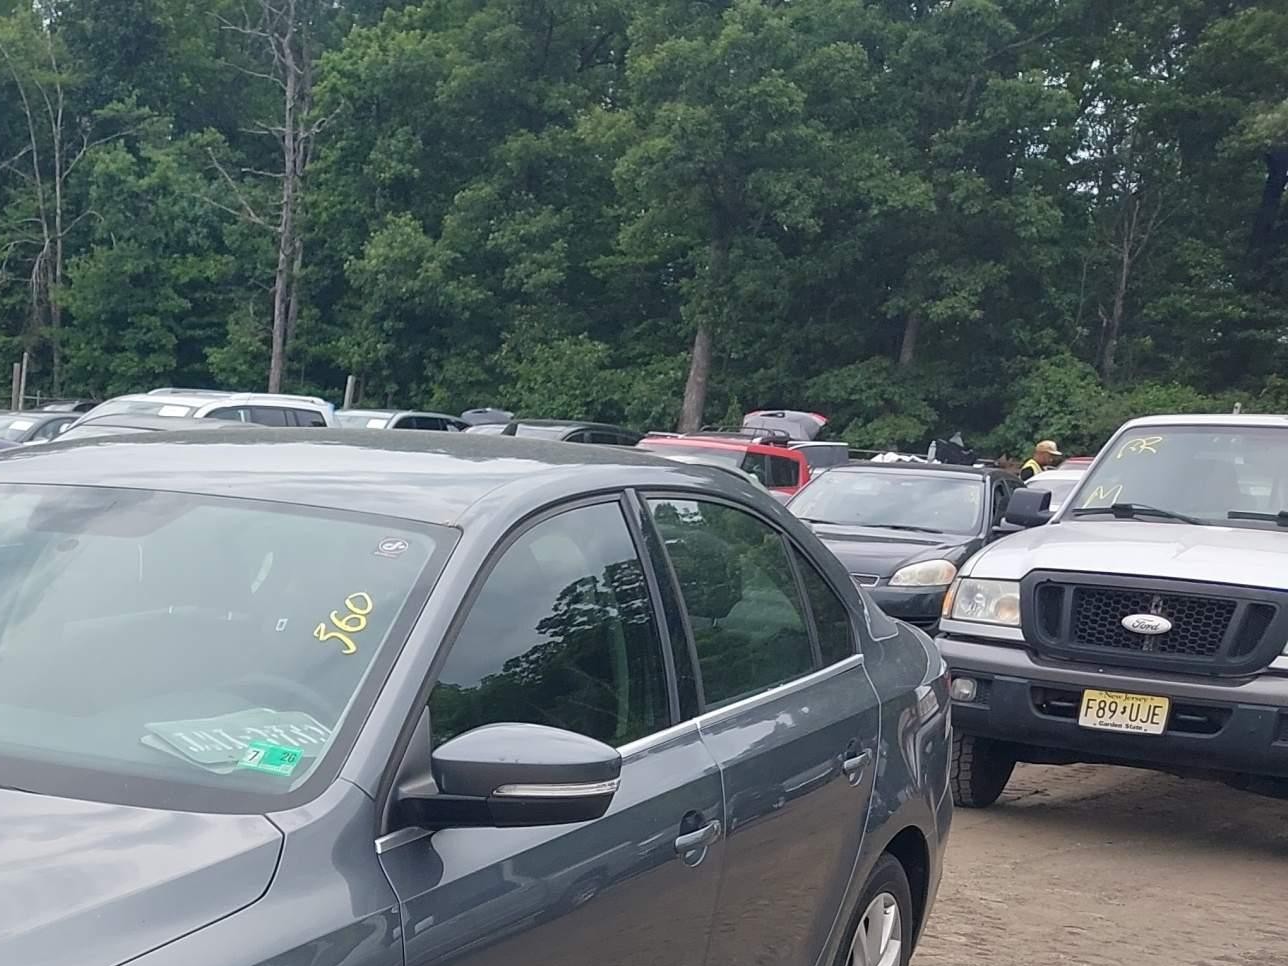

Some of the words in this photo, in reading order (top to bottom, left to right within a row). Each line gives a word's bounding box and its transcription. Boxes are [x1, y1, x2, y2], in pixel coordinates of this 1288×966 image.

[313, 591, 373, 655] 360
[1132, 618, 1161, 631] Ford
[1104, 691, 1122, 700] New
[1124, 693, 1146, 702] Jersey
[1084, 698, 1119, 719] F89
[1128, 702, 1164, 725] UJE
[1098, 720, 1123, 729] Garden
[1125, 722, 1143, 731] State
[249, 750, 261, 761] 7
[279, 751, 297, 763] 26
